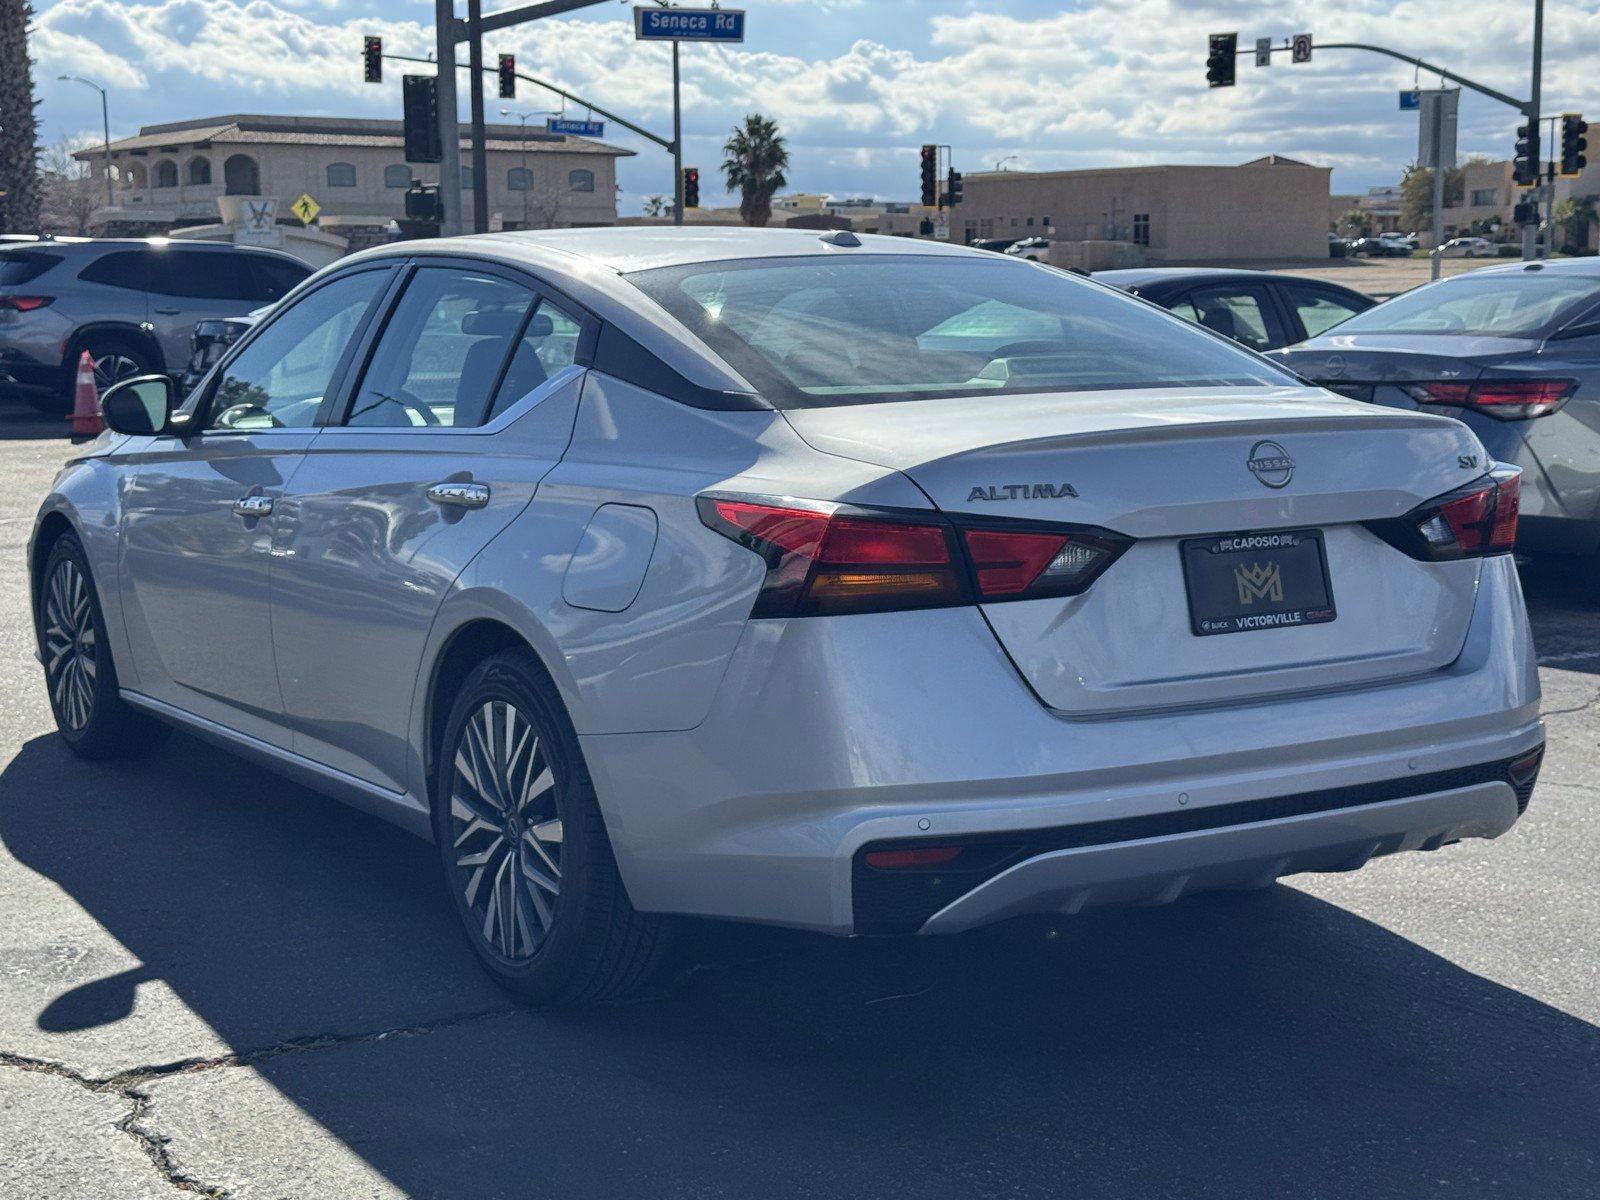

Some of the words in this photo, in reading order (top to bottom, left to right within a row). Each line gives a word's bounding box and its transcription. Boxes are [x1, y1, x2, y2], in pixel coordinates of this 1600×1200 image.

[650, 12, 708, 29] Seneca
[715, 14, 735, 30] Rd
[556, 121, 586, 131] Seneca
[1457, 455, 1477, 469] SV
[967, 483, 1080, 502] ALTIMA
[1233, 535, 1280, 549] CAPOSIO
[1211, 622, 1229, 630] BUICK
[1236, 611, 1302, 629] VICTORVILLE
